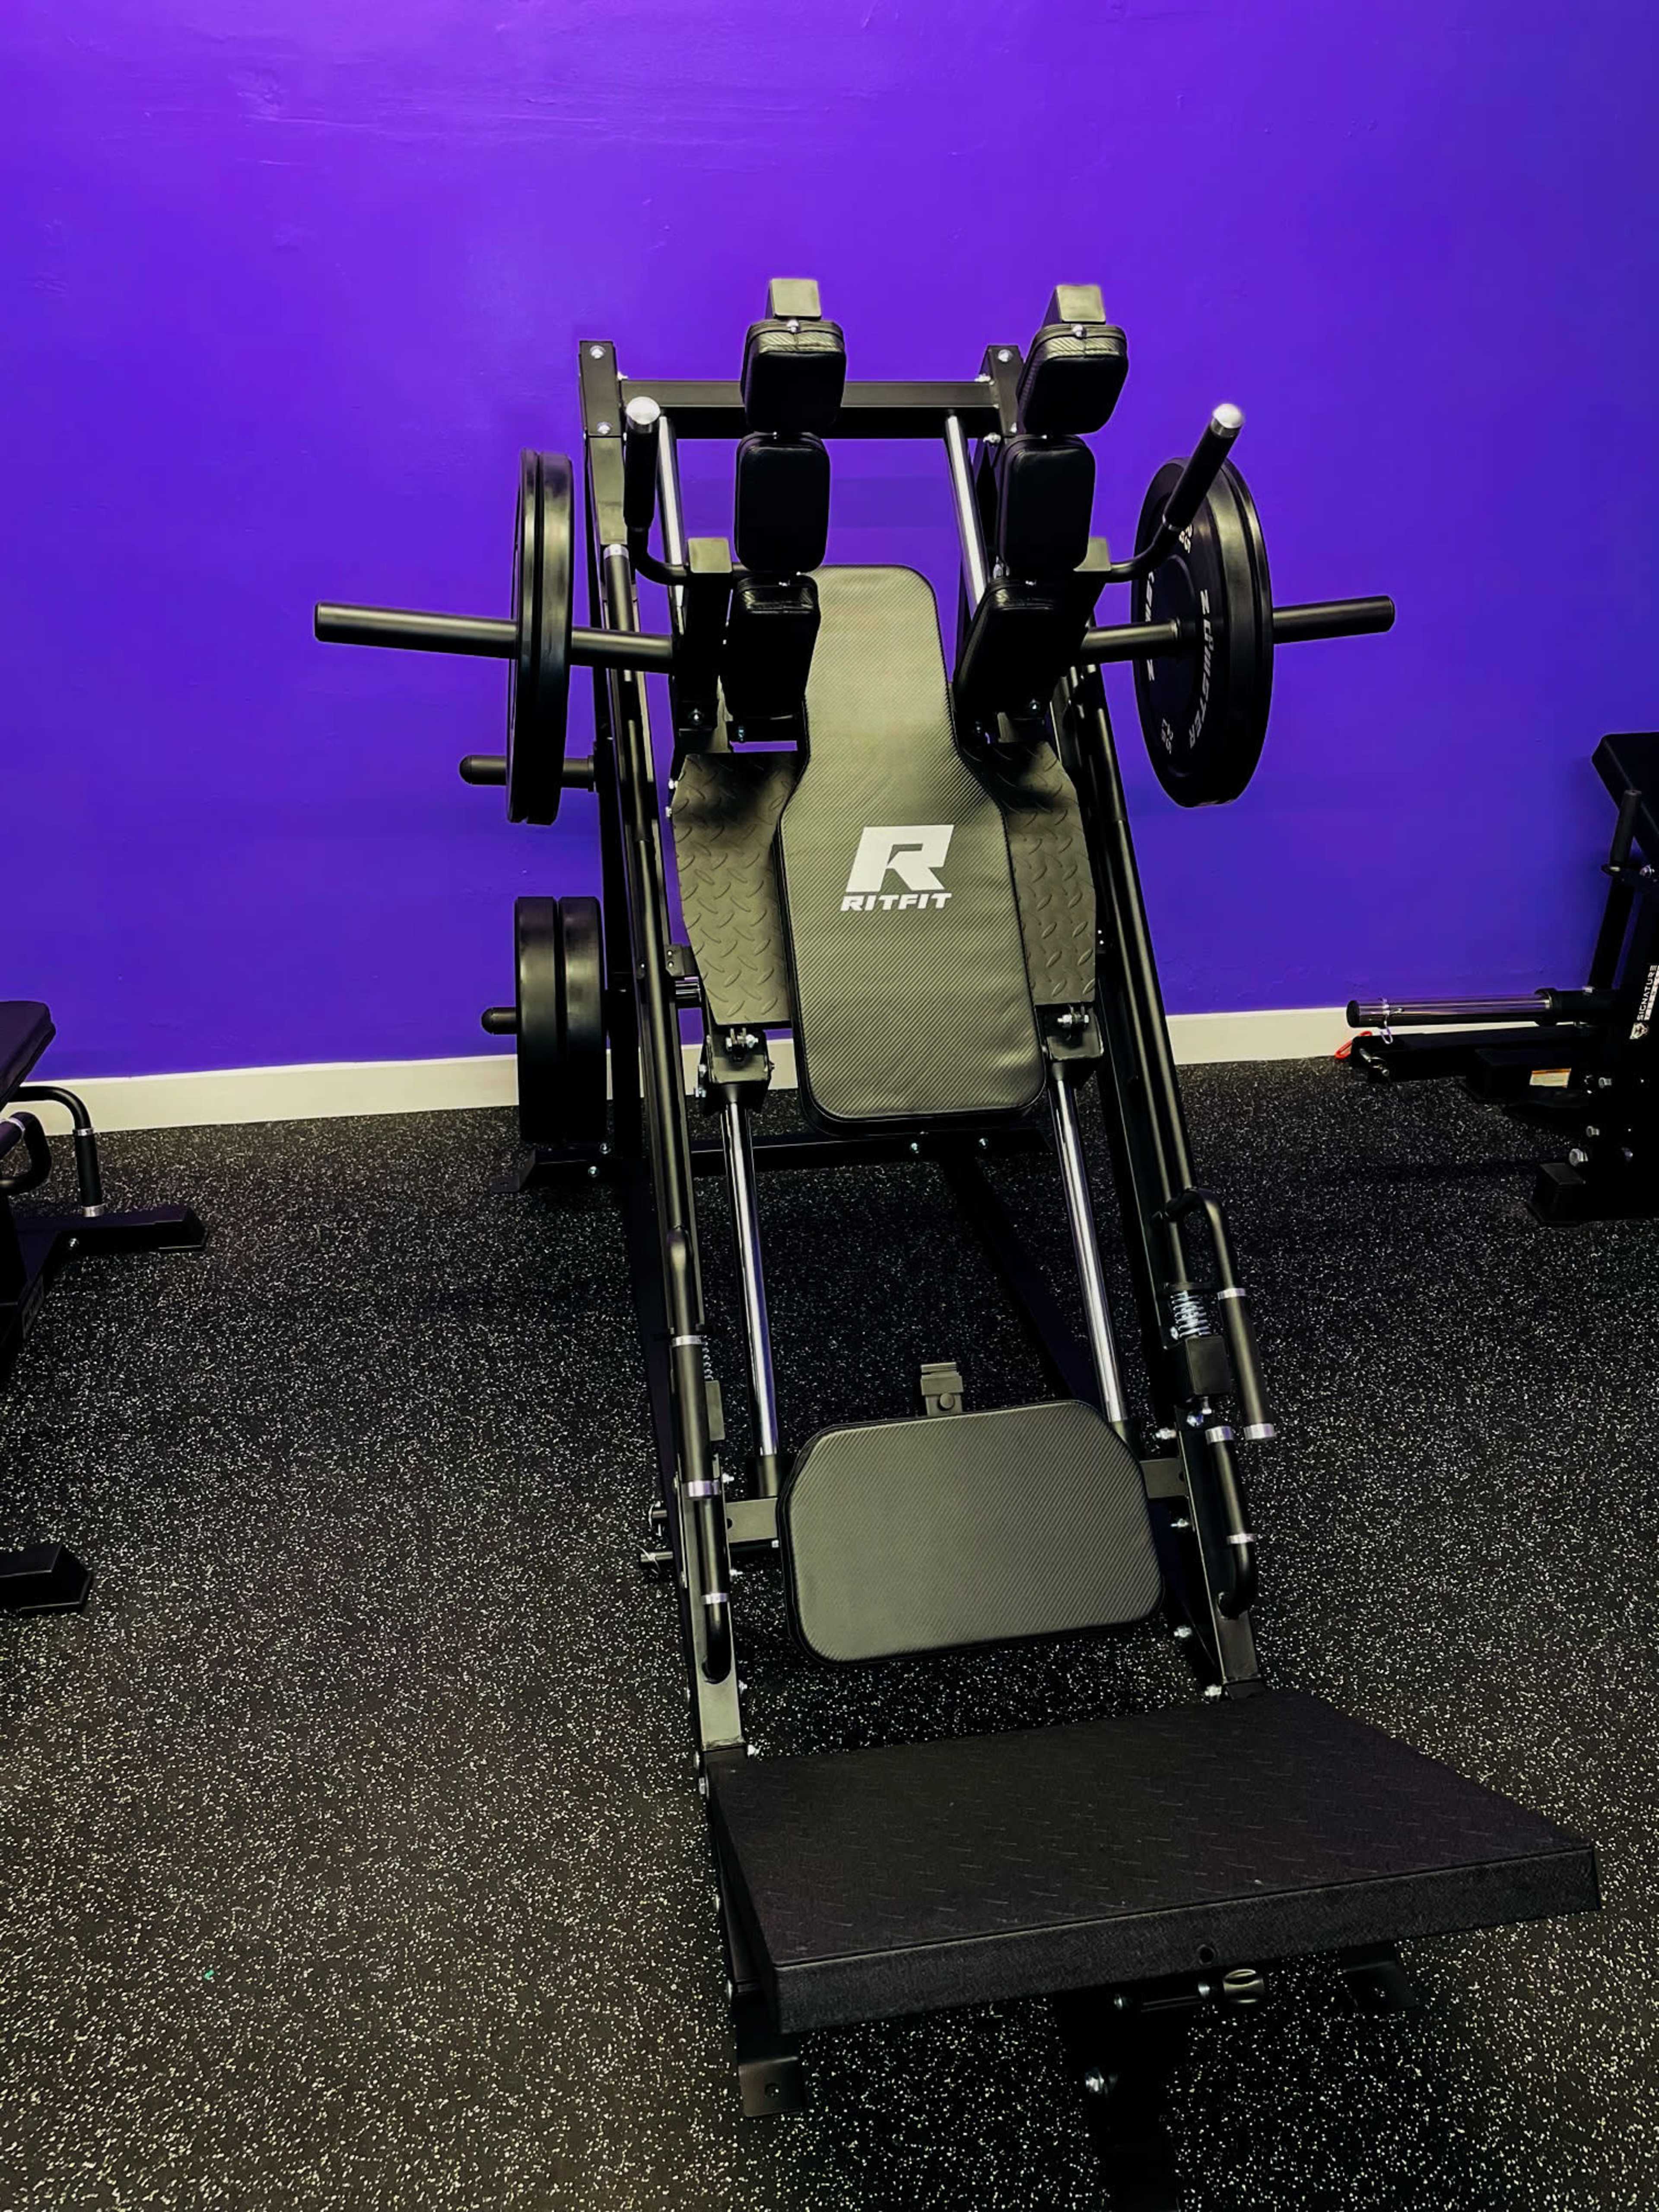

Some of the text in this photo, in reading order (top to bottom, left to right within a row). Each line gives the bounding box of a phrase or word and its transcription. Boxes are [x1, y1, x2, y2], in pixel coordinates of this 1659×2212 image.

[845, 824, 954, 893] R
[839, 893, 953, 912] RITFIT
[1637, 965, 1657, 1021] SIGNATURE
